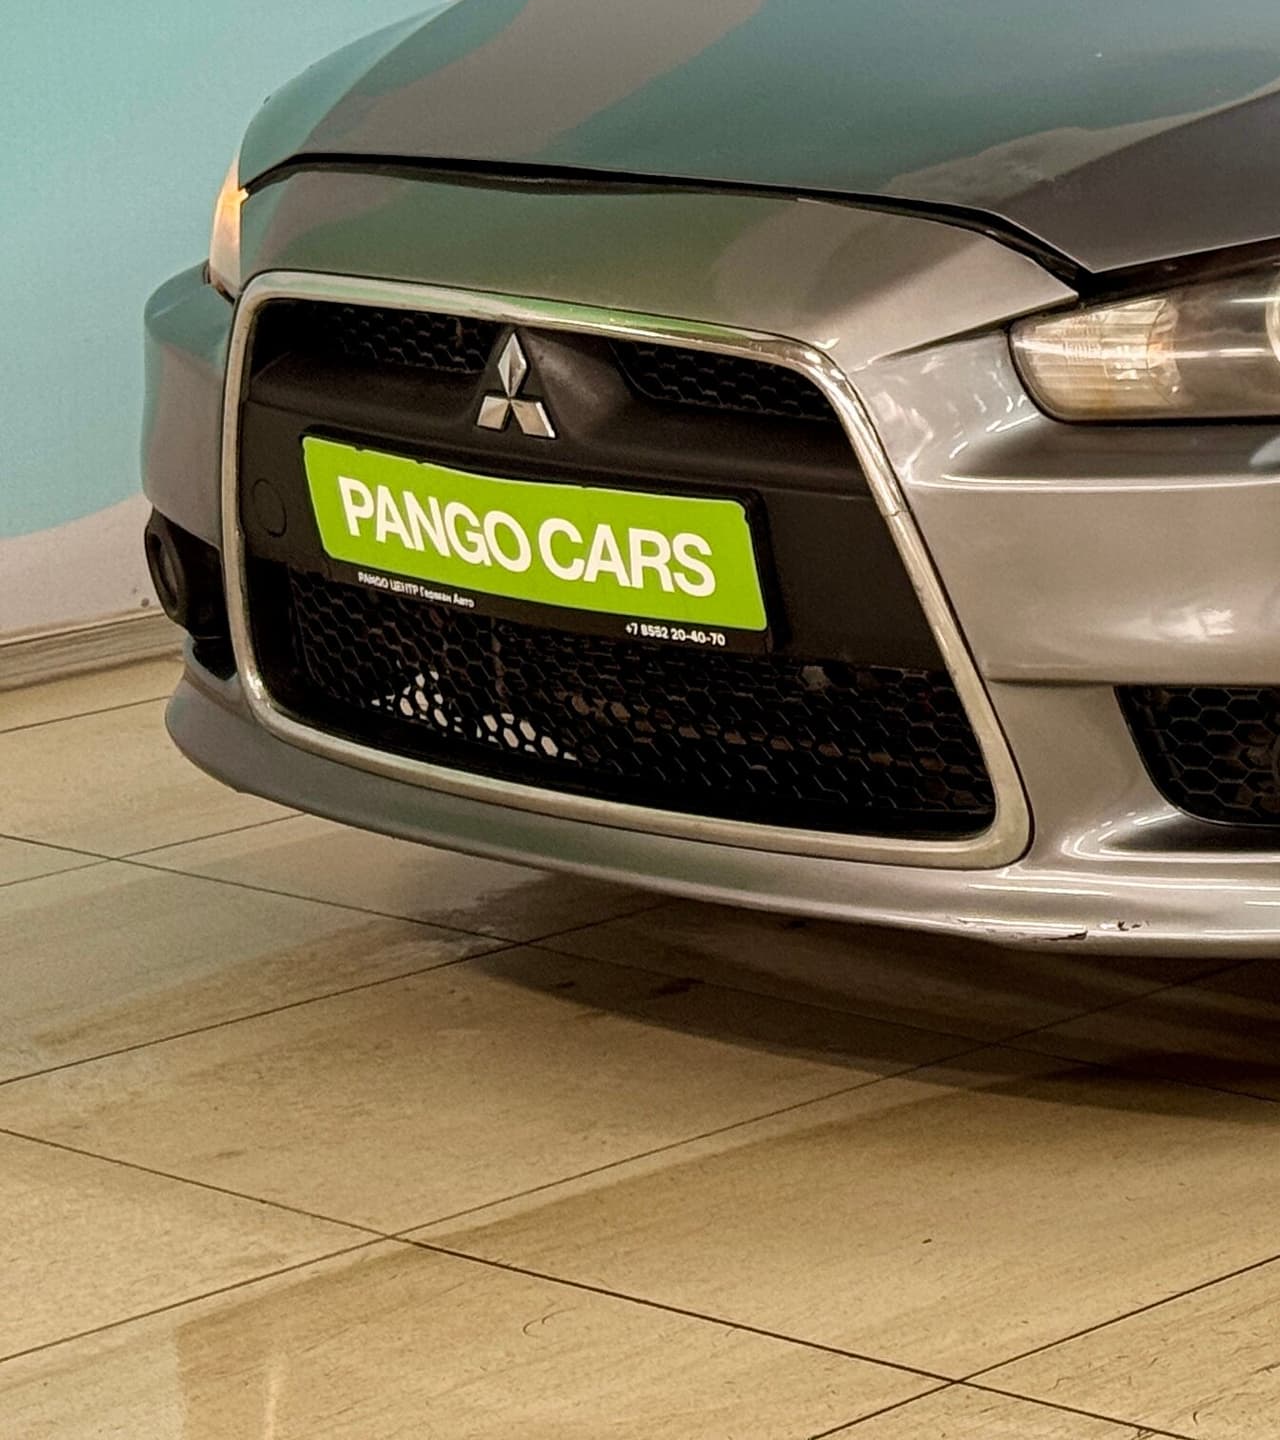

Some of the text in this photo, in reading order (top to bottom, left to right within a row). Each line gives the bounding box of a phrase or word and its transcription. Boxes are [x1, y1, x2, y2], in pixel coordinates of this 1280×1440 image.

[337, 476, 717, 597] PANGO CARS
[625, 622, 638, 635] +7
[670, 628, 726, 646] 20-40-70
